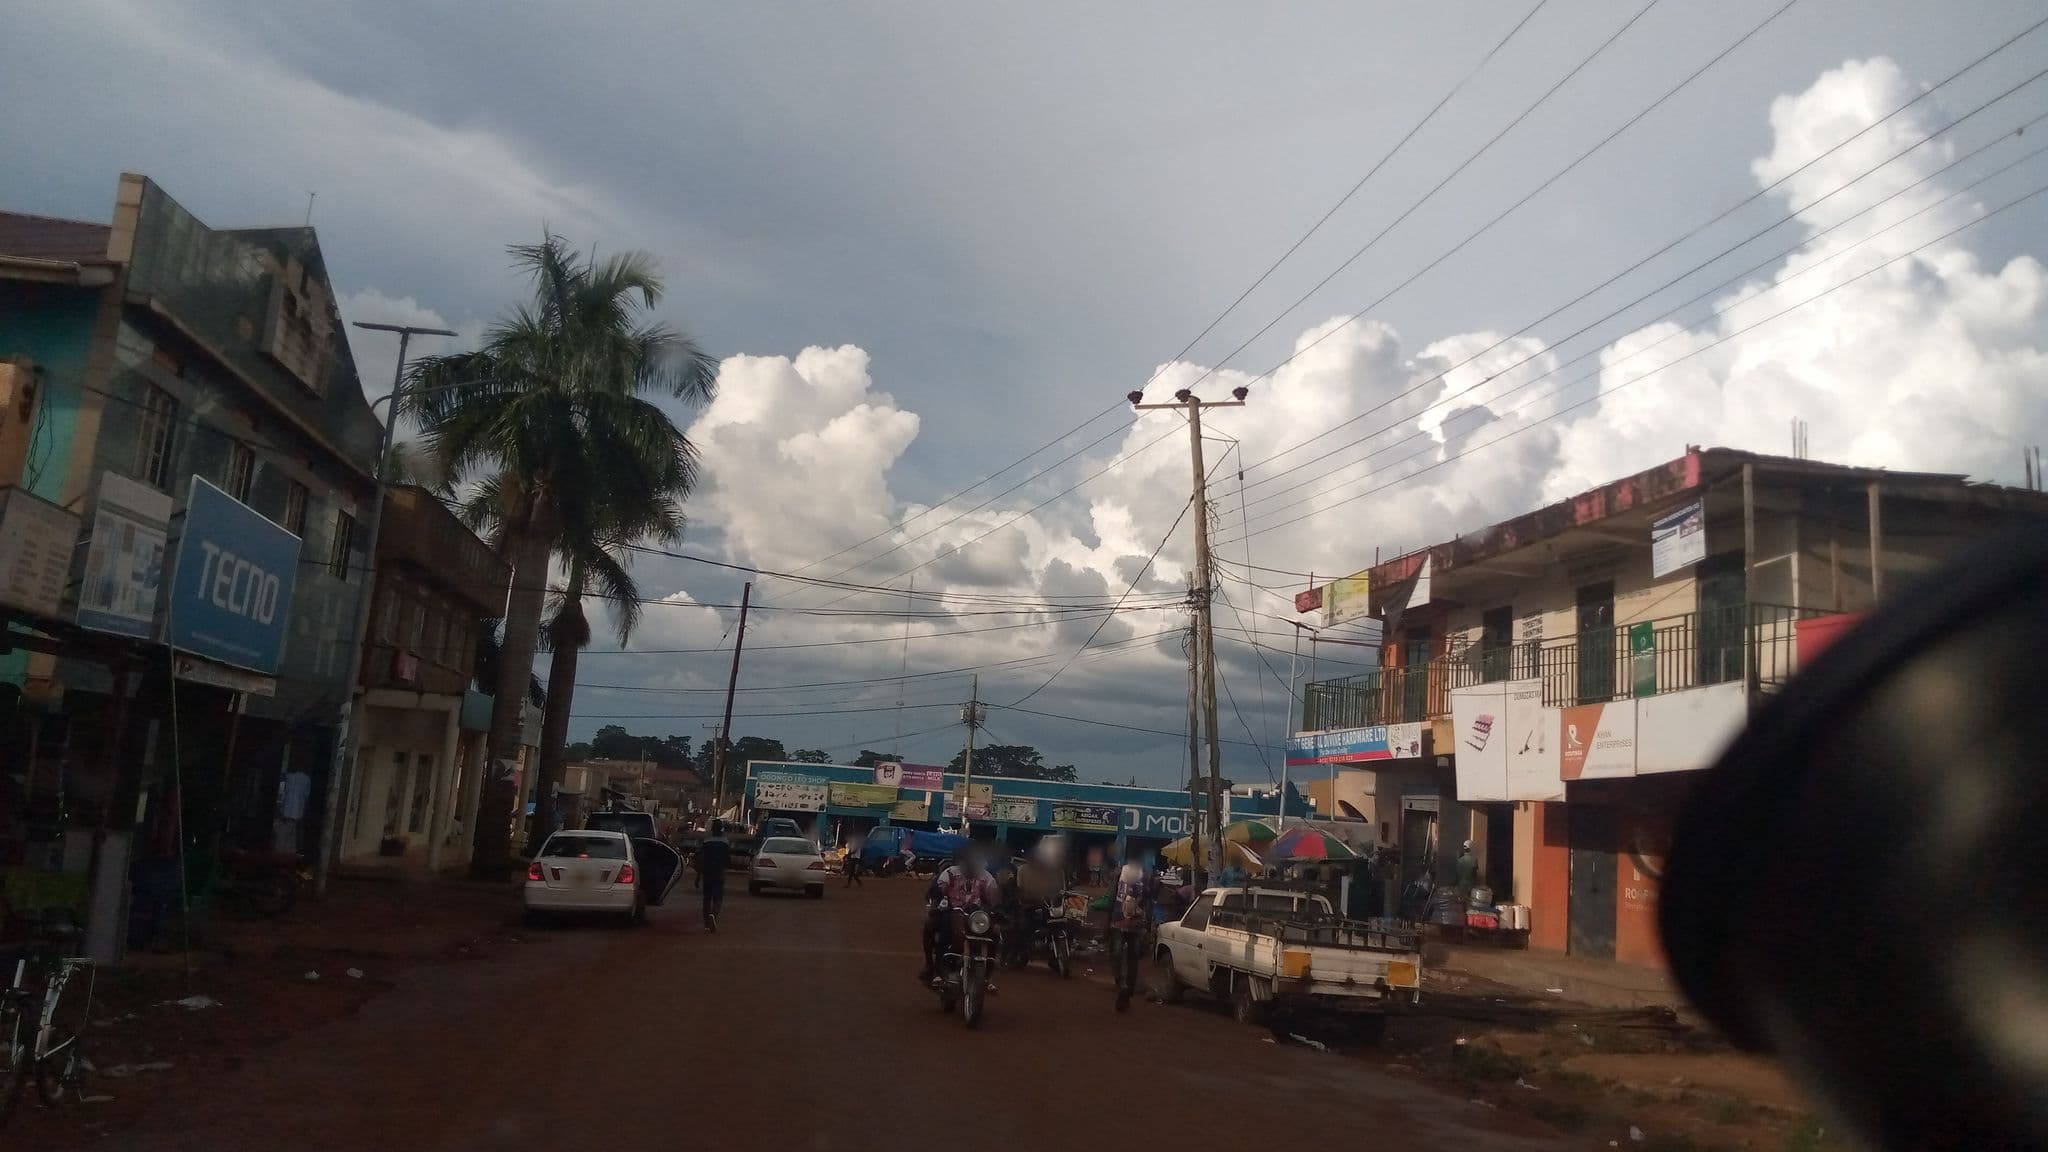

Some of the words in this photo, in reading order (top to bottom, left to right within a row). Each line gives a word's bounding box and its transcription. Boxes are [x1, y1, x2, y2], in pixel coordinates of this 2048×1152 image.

[197, 539, 280, 625] TECNO
[1342, 729, 1373, 746] HARDWARE
[1375, 727, 1386, 741] LTD
